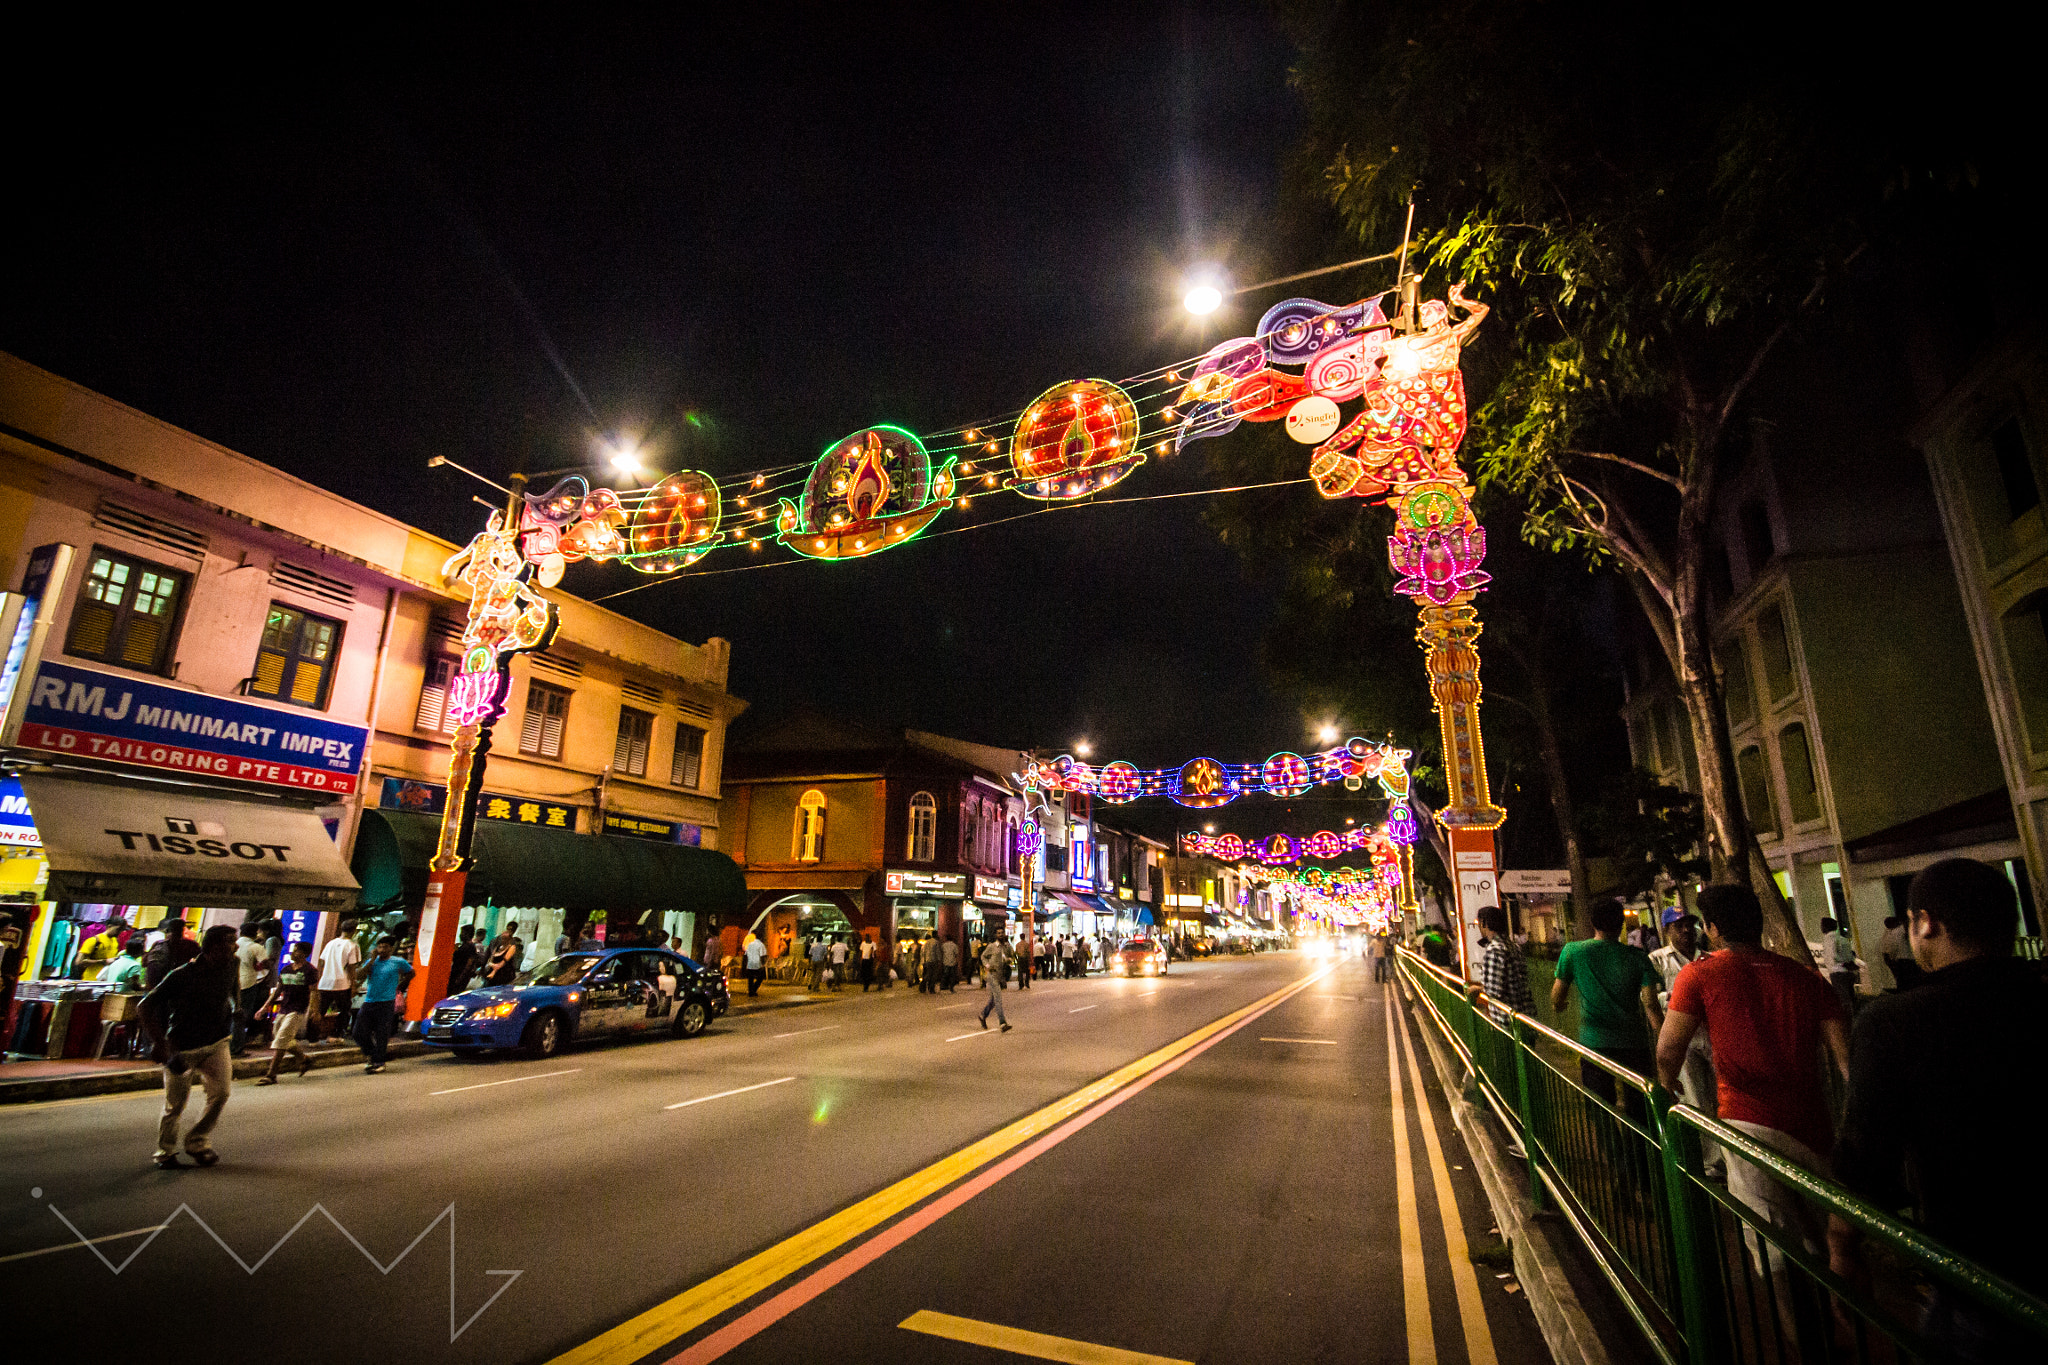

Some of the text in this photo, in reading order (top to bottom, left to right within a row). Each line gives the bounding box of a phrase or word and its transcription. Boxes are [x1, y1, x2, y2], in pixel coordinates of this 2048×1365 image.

[1305, 411, 1336, 422] SingTel
[31, 675, 354, 761] RMJ MINIMART IMPEX
[41, 730, 327, 787] LD TAILORING PTE LTD
[333, 780, 348, 790] 172
[104, 828, 291, 862] TISSOT
